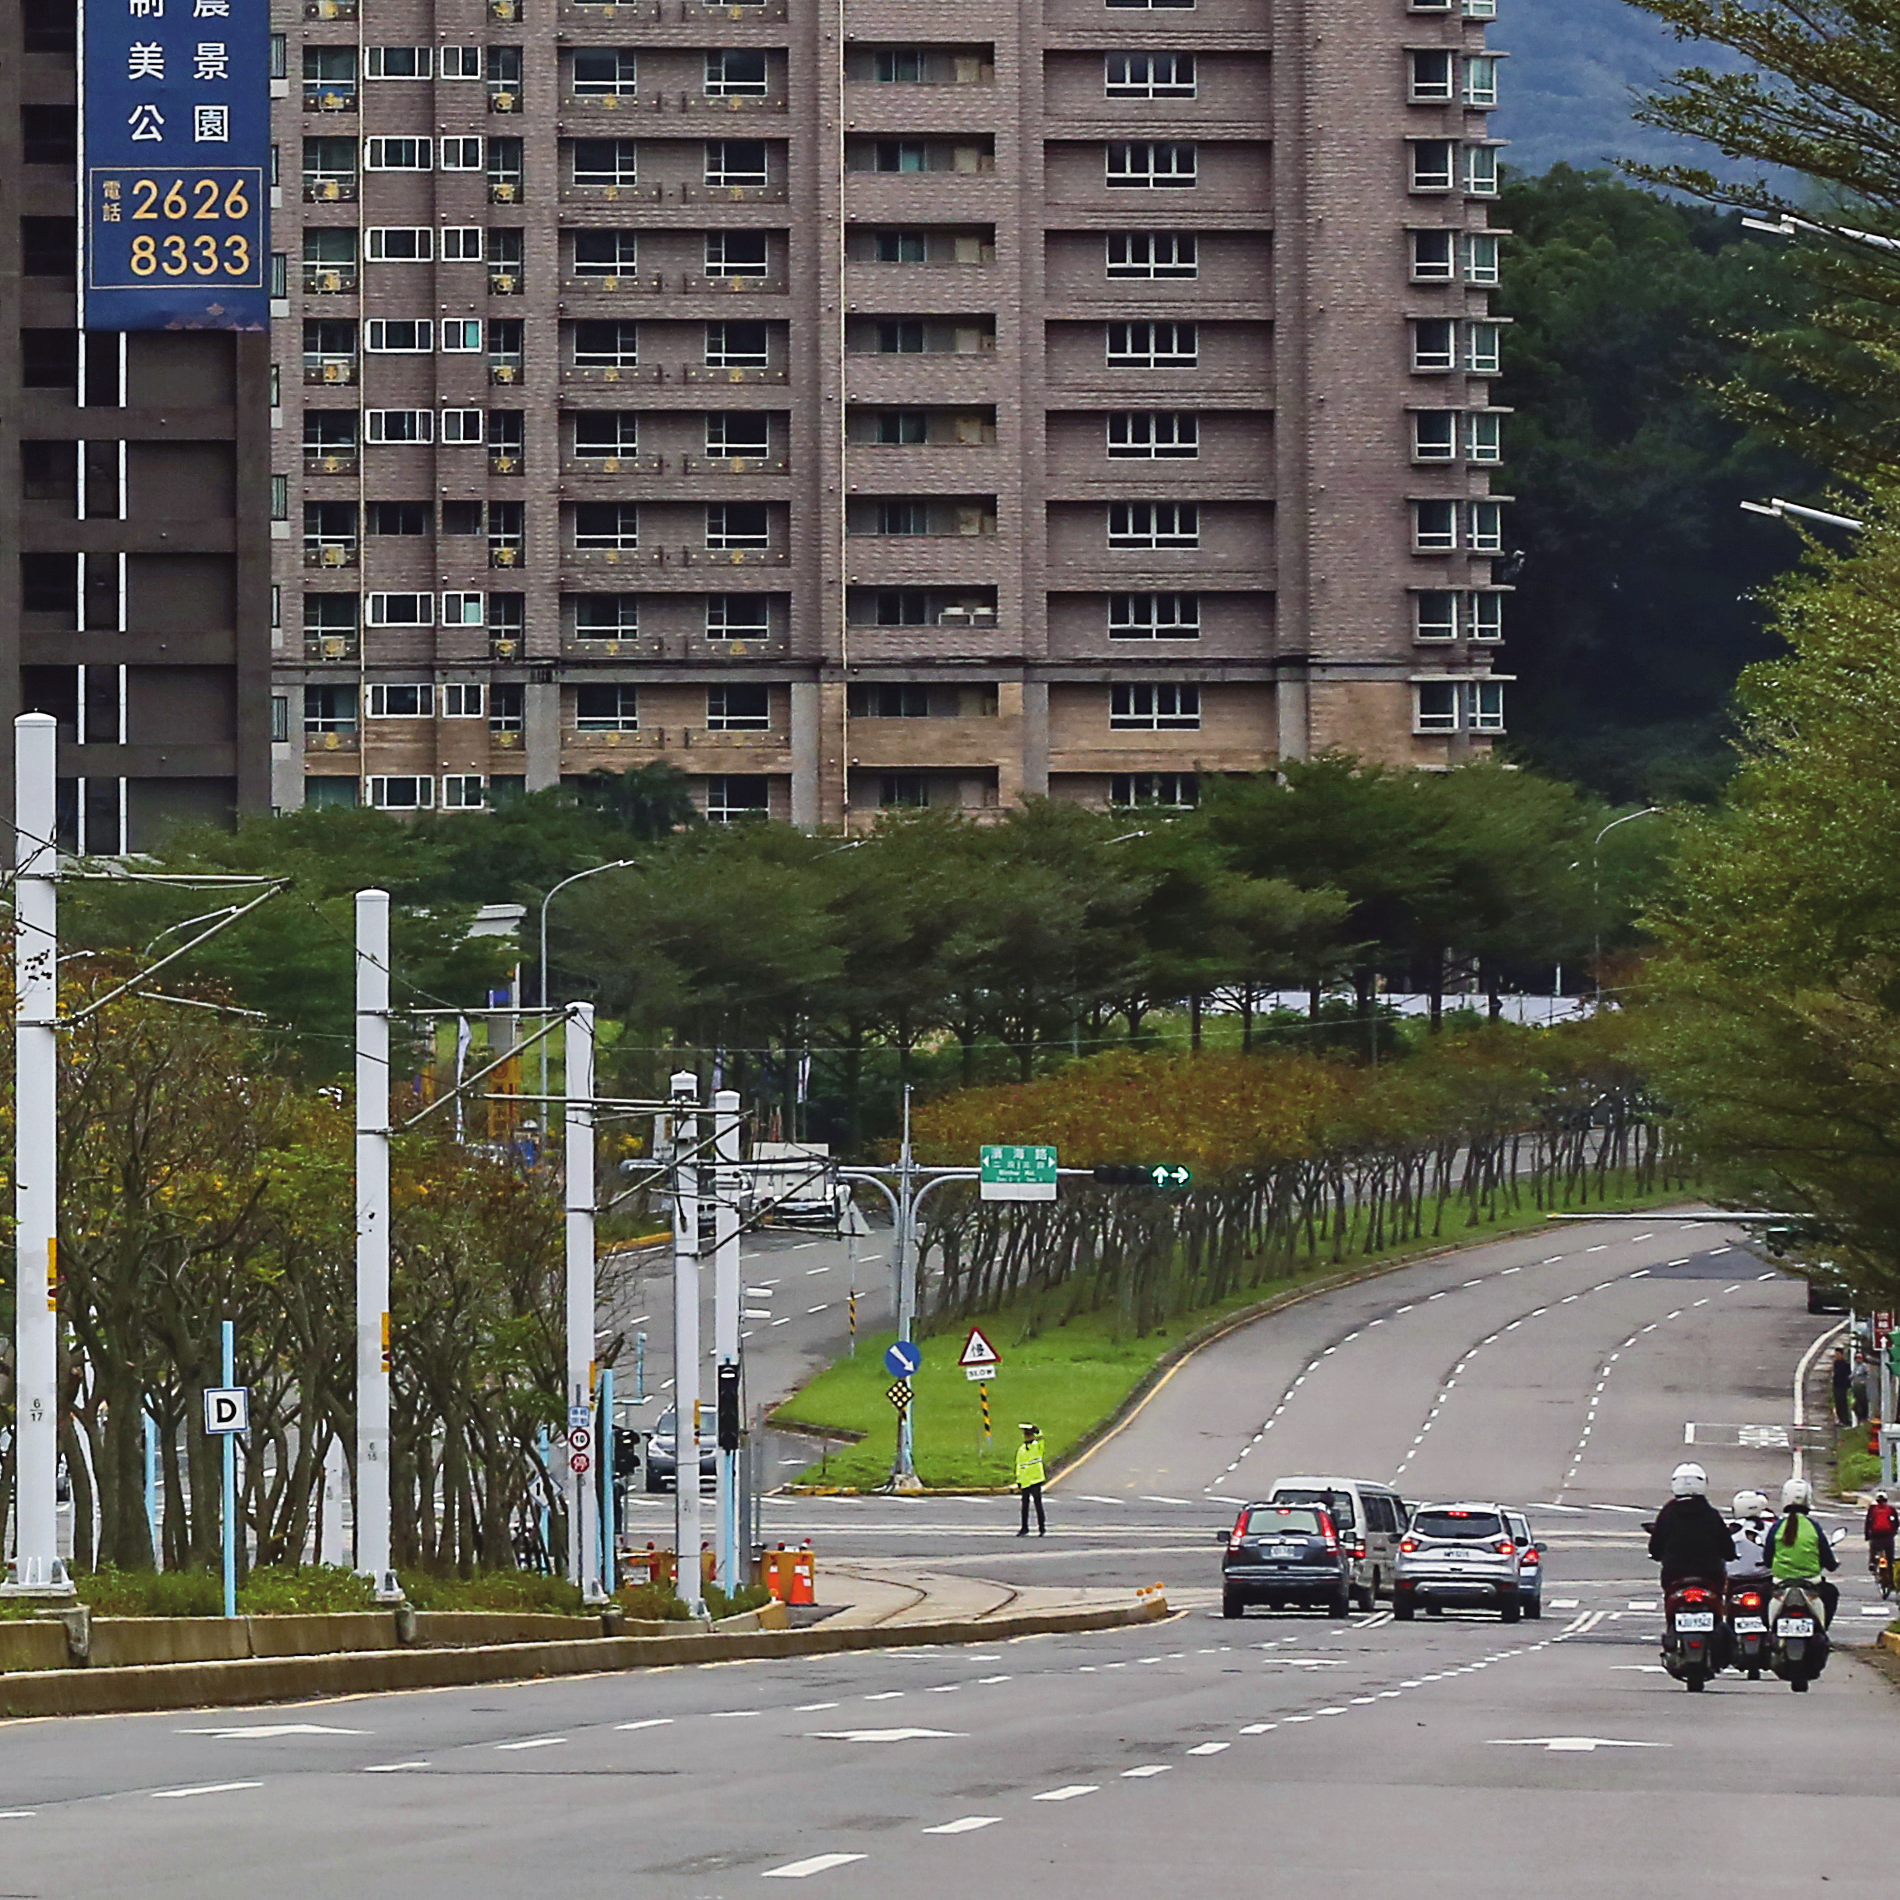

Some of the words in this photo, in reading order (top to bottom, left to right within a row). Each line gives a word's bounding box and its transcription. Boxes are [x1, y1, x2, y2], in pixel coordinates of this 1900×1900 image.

[103, 179, 121, 222] 電話
[131, 179, 249, 220] 2626
[130, 235, 250, 276] 8333
[31, 1412, 43, 1422] 17
[216, 1398, 237, 1423] D
[575, 1434, 586, 1444] 10
